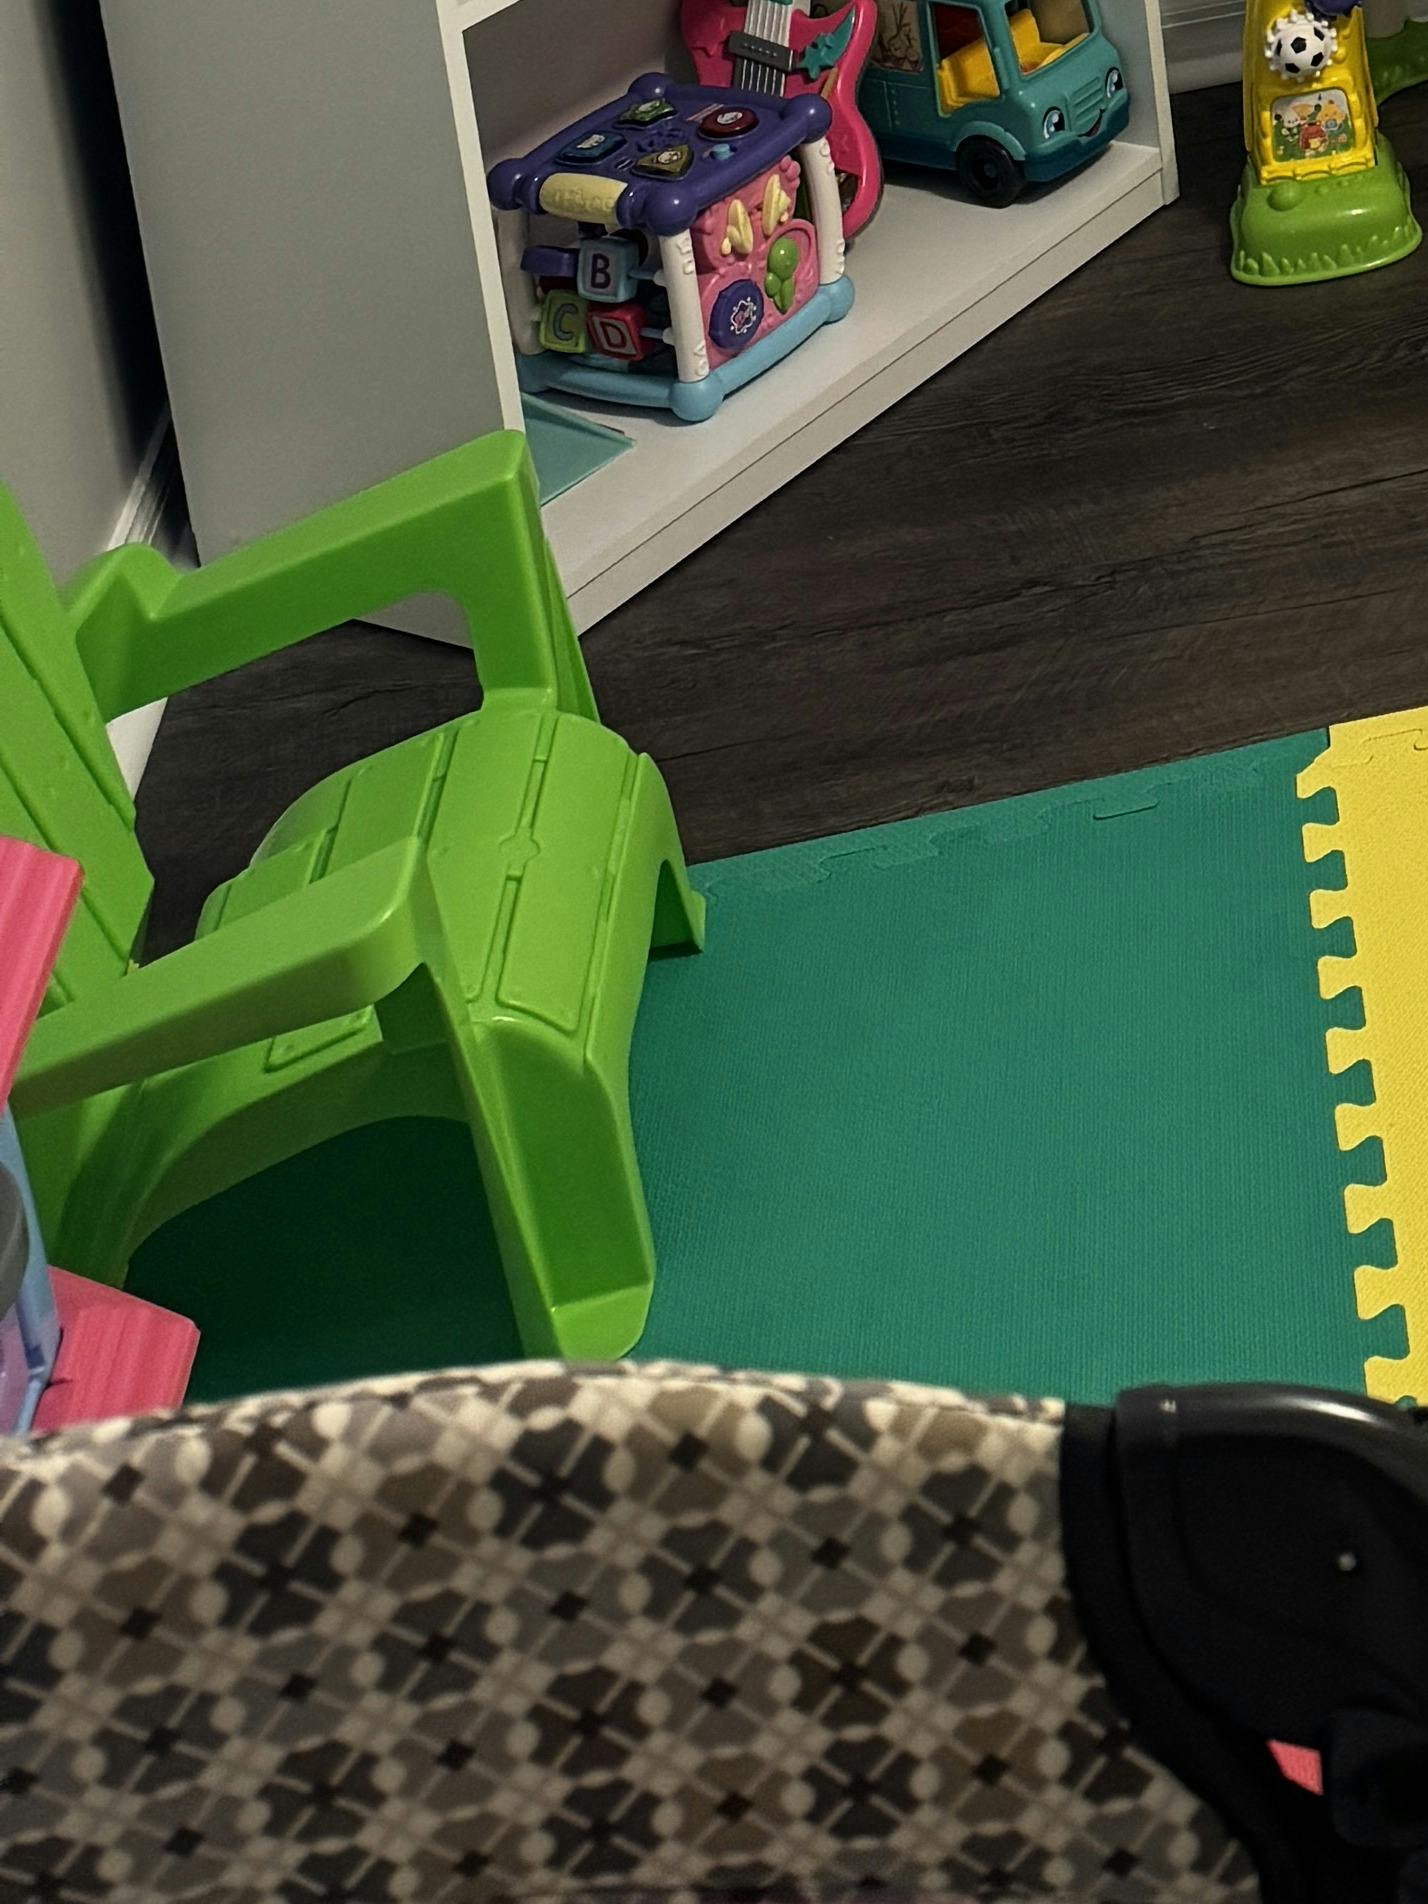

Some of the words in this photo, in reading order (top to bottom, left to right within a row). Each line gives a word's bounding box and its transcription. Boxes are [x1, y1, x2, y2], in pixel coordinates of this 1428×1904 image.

[590, 252, 611, 289] B
[553, 303, 578, 341] C
[603, 320, 627, 349] D
